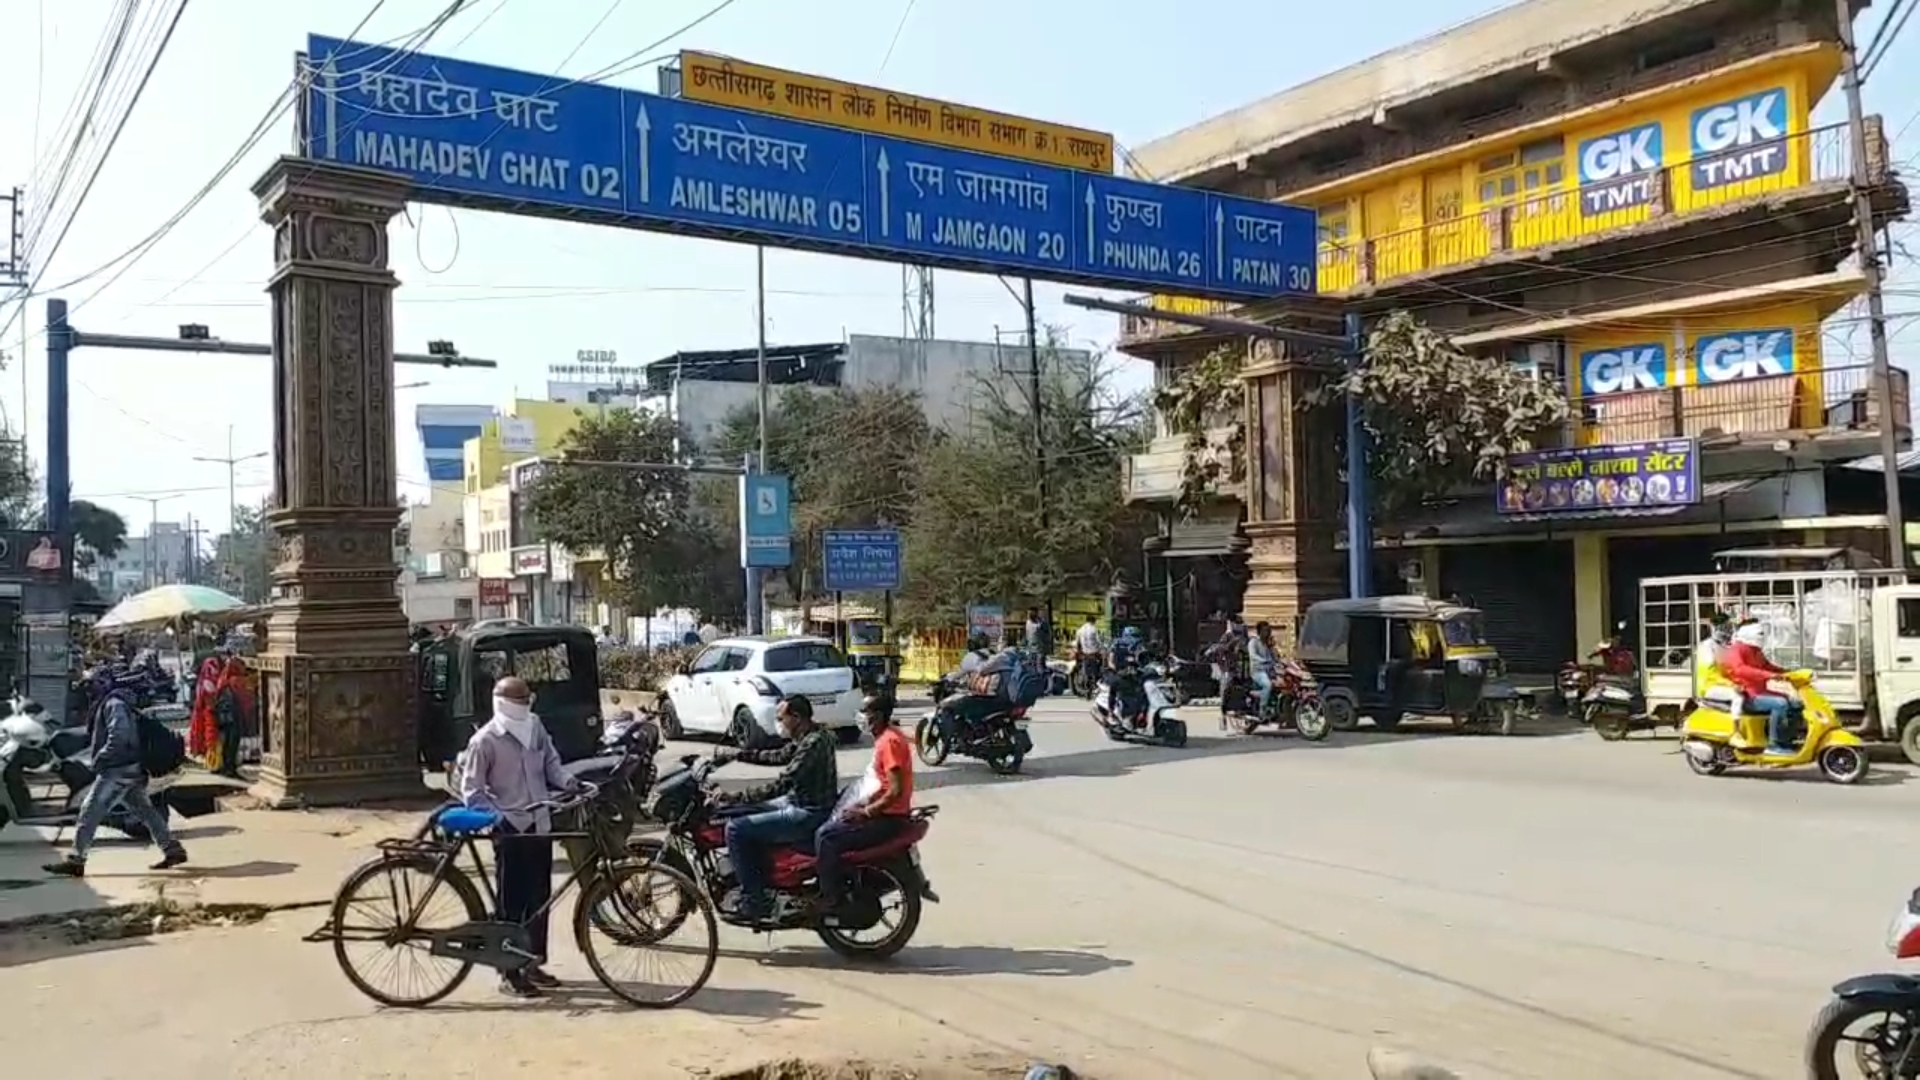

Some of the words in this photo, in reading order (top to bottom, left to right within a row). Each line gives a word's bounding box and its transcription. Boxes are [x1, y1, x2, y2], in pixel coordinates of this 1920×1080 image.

[358, 64, 479, 120] महादेव
[491, 89, 560, 132] घाट
[1695, 93, 1786, 152] GK
[672, 120, 808, 174] अमलेश्वर
[785, 82, 832, 112] शासन
[841, 88, 876, 119] लोक
[885, 94, 932, 131] निर्माण
[1067, 136, 1106, 168] रायपुर
[354, 129, 491, 181] MAHADEV
[500, 151, 570, 190] GHAT
[580, 163, 621, 199] 02
[1582, 127, 1657, 181] GK
[1700, 146, 1778, 185] TMT
[670, 175, 818, 227] AMLESHWAR
[828, 200, 862, 233] 05
[905, 161, 944, 198] एम
[954, 171, 1049, 211] जामगांव
[1586, 178, 1650, 212] TMT
[905, 211, 922, 241] M
[932, 216, 1026, 255] JAMGAON
[1037, 232, 1065, 261] 20
[1105, 194, 1162, 233] फुण्डा
[1234, 214, 1283, 247] पाटन
[1103, 240, 1171, 273] PHUNDA
[1177, 250, 1201, 278] 26
[1232, 257, 1280, 287] PATAN
[1288, 264, 1311, 291] 30
[1584, 347, 1661, 394] GK
[1701, 331, 1787, 382] GK
